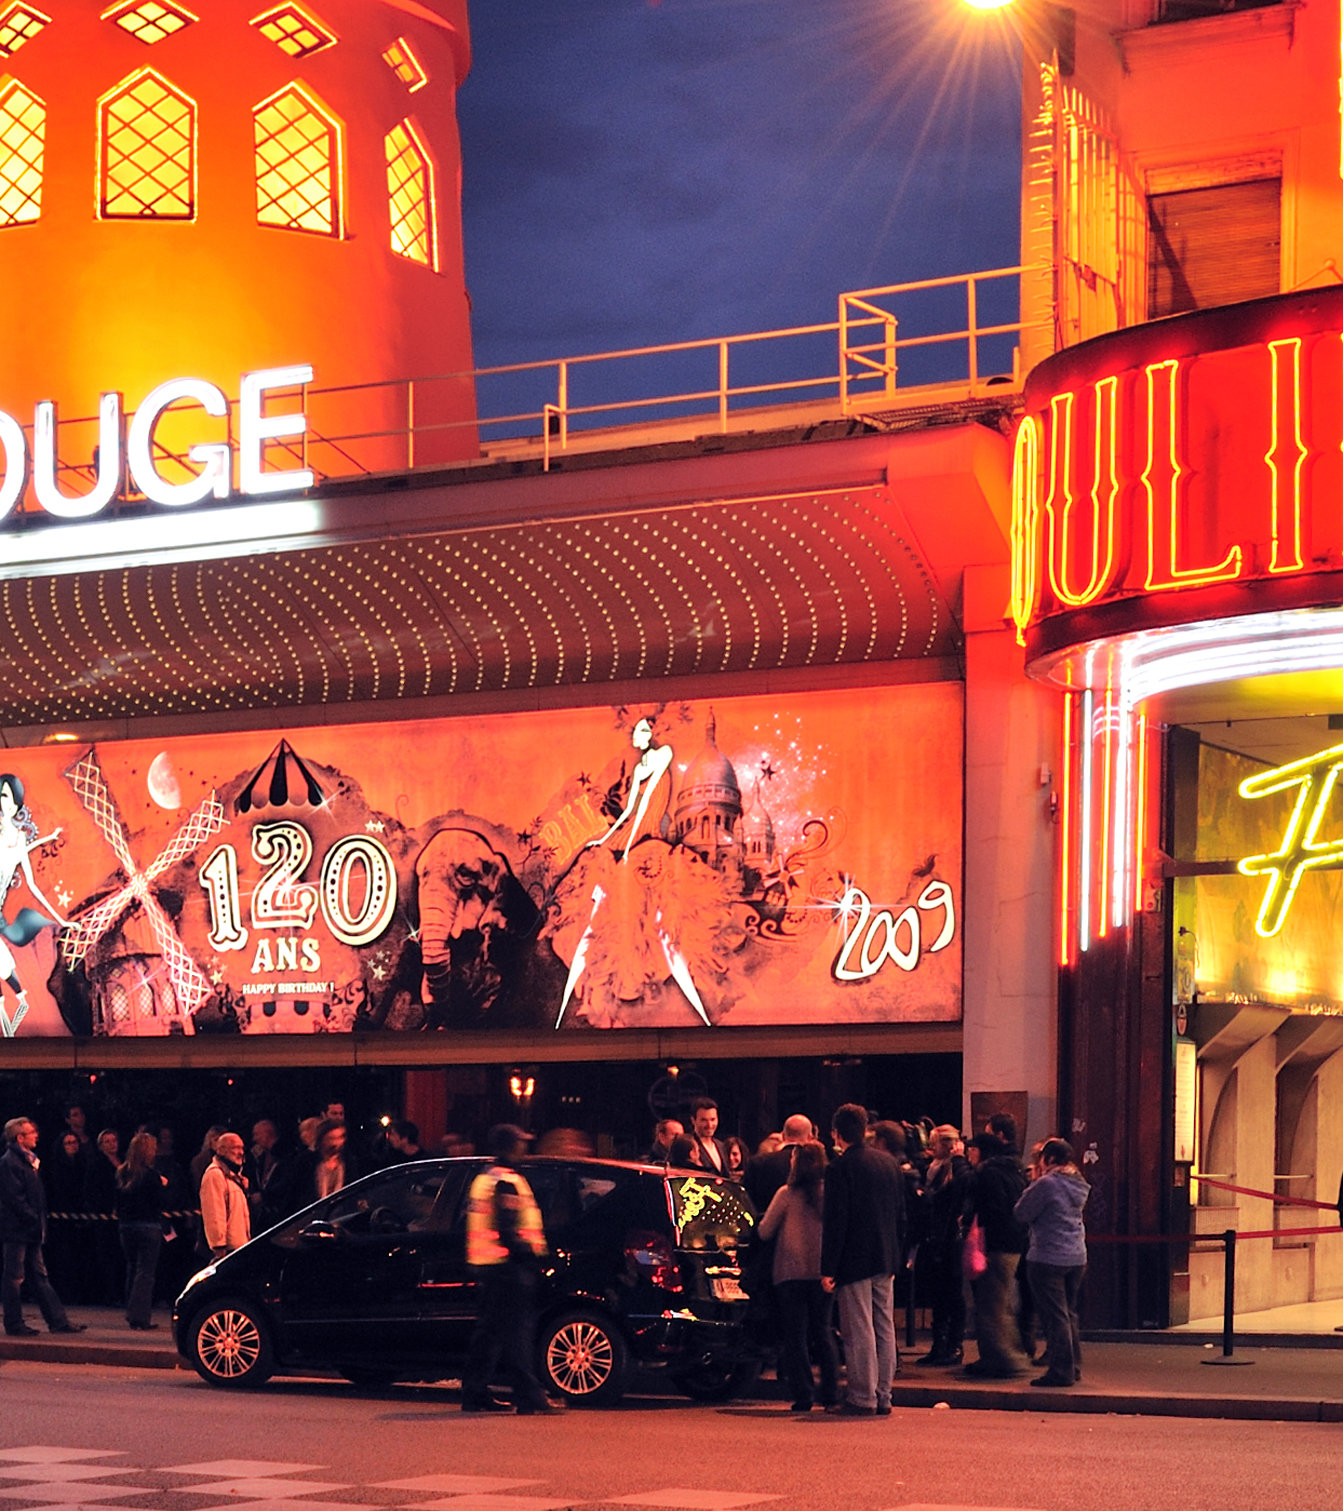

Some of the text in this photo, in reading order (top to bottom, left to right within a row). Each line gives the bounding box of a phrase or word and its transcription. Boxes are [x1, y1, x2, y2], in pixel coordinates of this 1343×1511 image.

[199, 821, 397, 952] 120
[251, 937, 321, 974] ANS
[834, 880, 955, 981] 2009
[243, 983, 276, 994] HAPPY
[278, 982, 328, 994] BIRTHDAY
